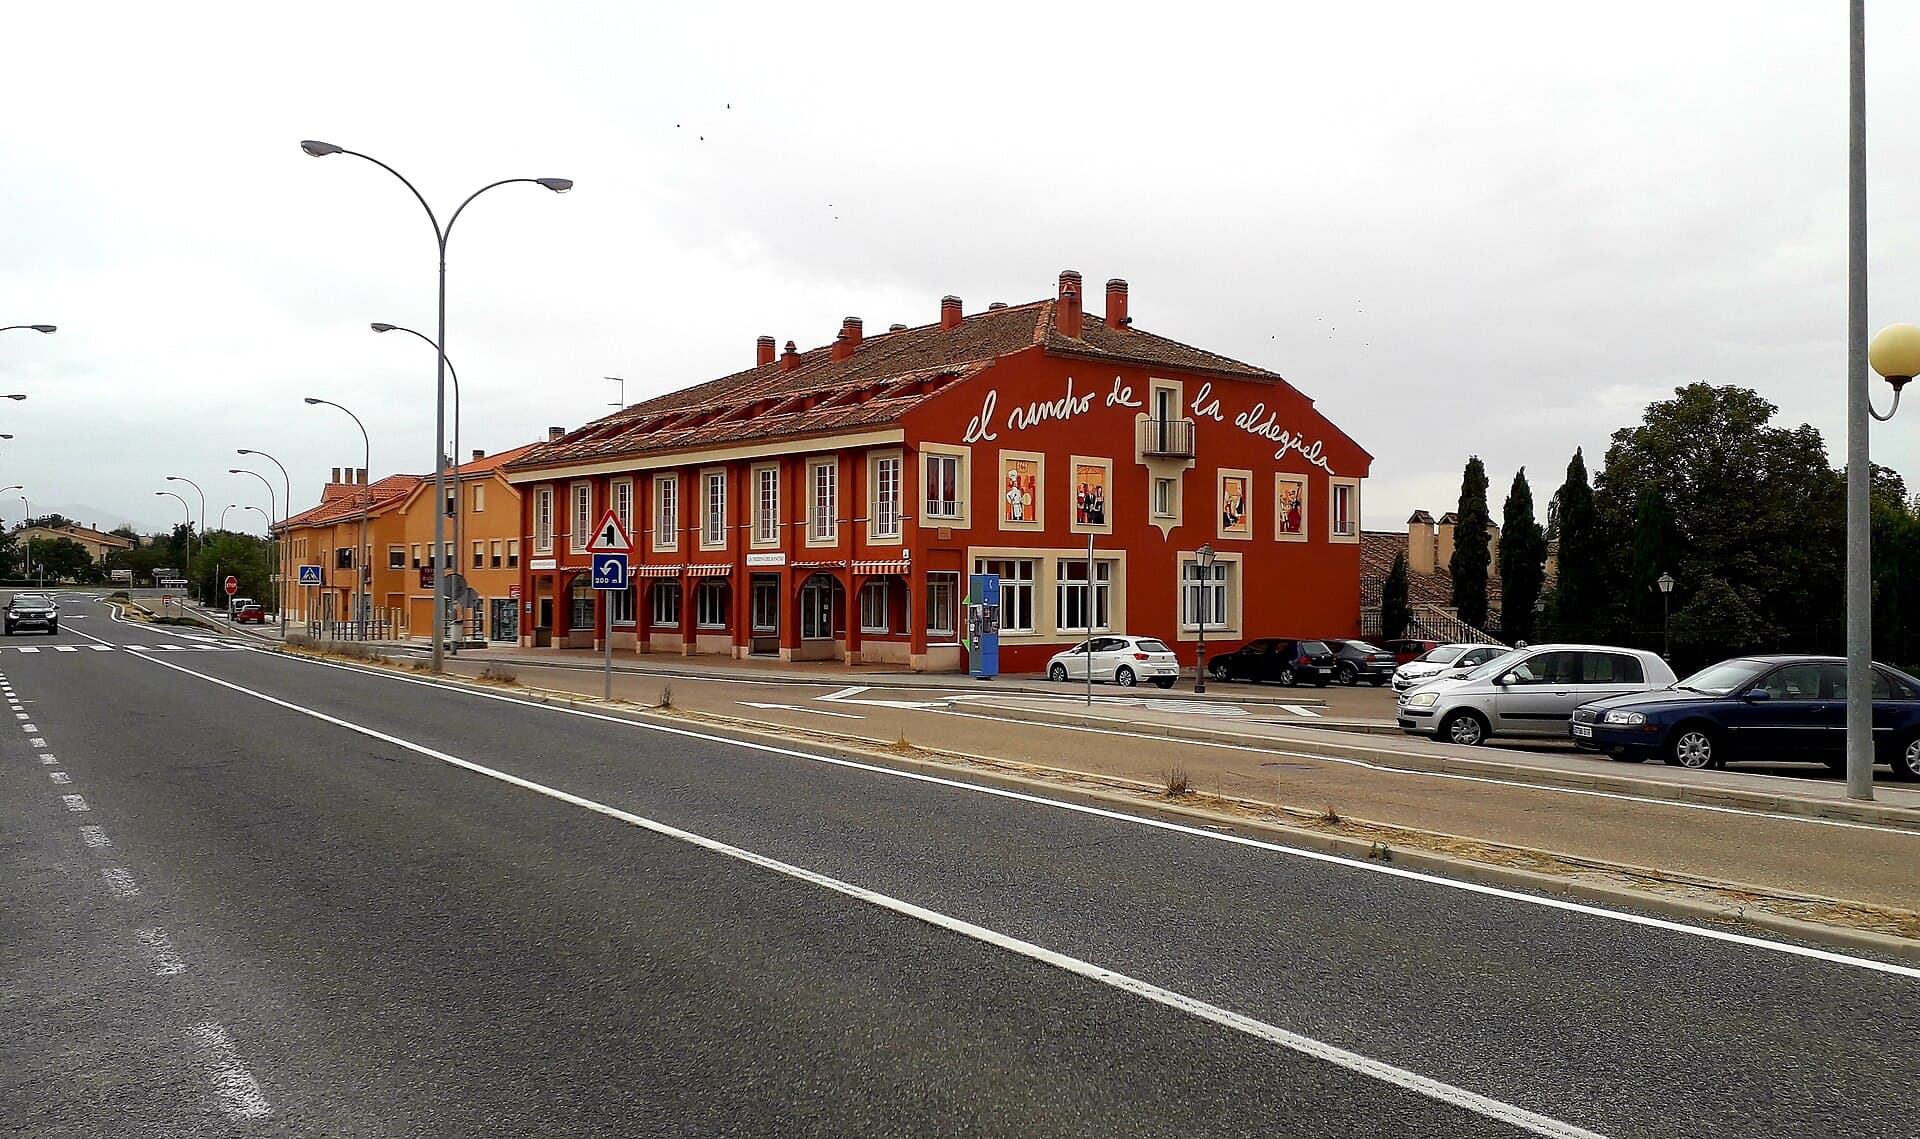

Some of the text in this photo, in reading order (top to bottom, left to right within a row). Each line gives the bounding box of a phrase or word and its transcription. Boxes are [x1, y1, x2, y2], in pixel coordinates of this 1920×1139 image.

[962, 376, 1335, 475] el rancho de la aldegüela
